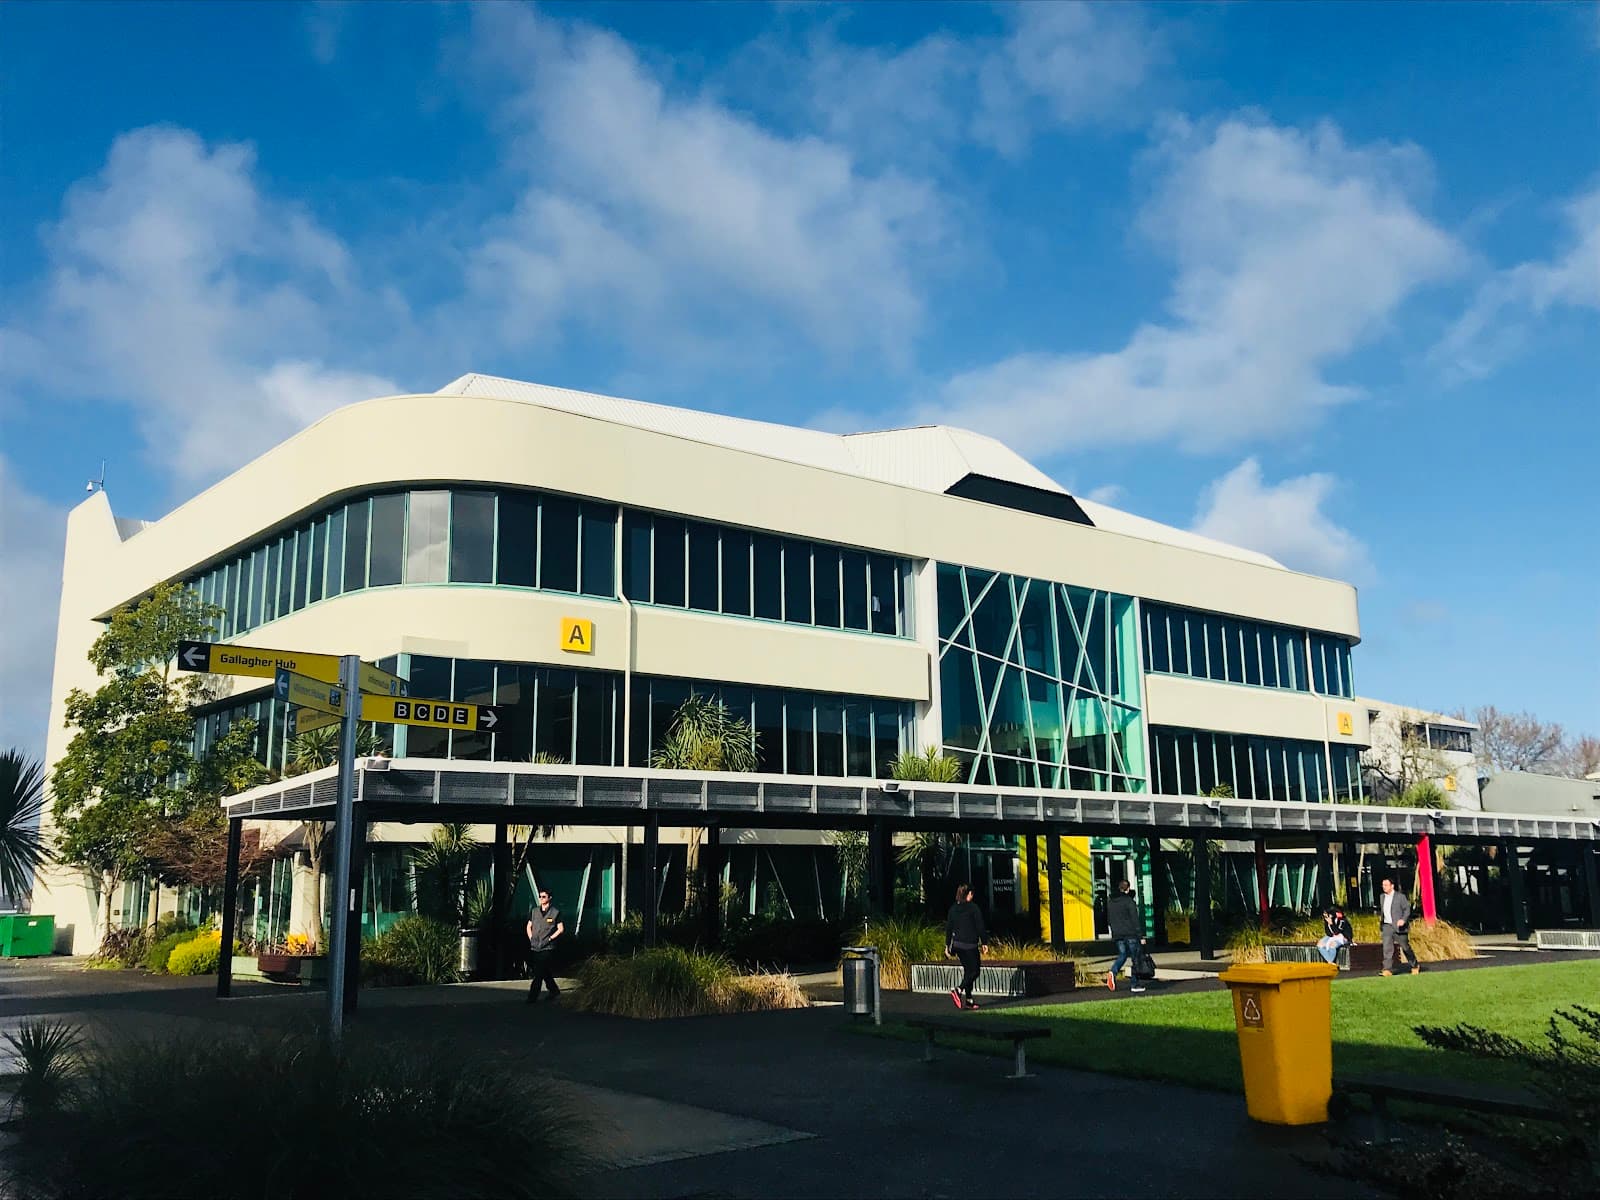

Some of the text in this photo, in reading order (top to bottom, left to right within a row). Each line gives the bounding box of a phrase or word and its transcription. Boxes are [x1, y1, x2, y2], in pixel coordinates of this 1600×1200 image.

[568, 624, 585, 645] A
[220, 653, 296, 670] Gallagher Hub
[397, 703, 465, 723] B C D E
[1343, 716, 1350, 730] A
